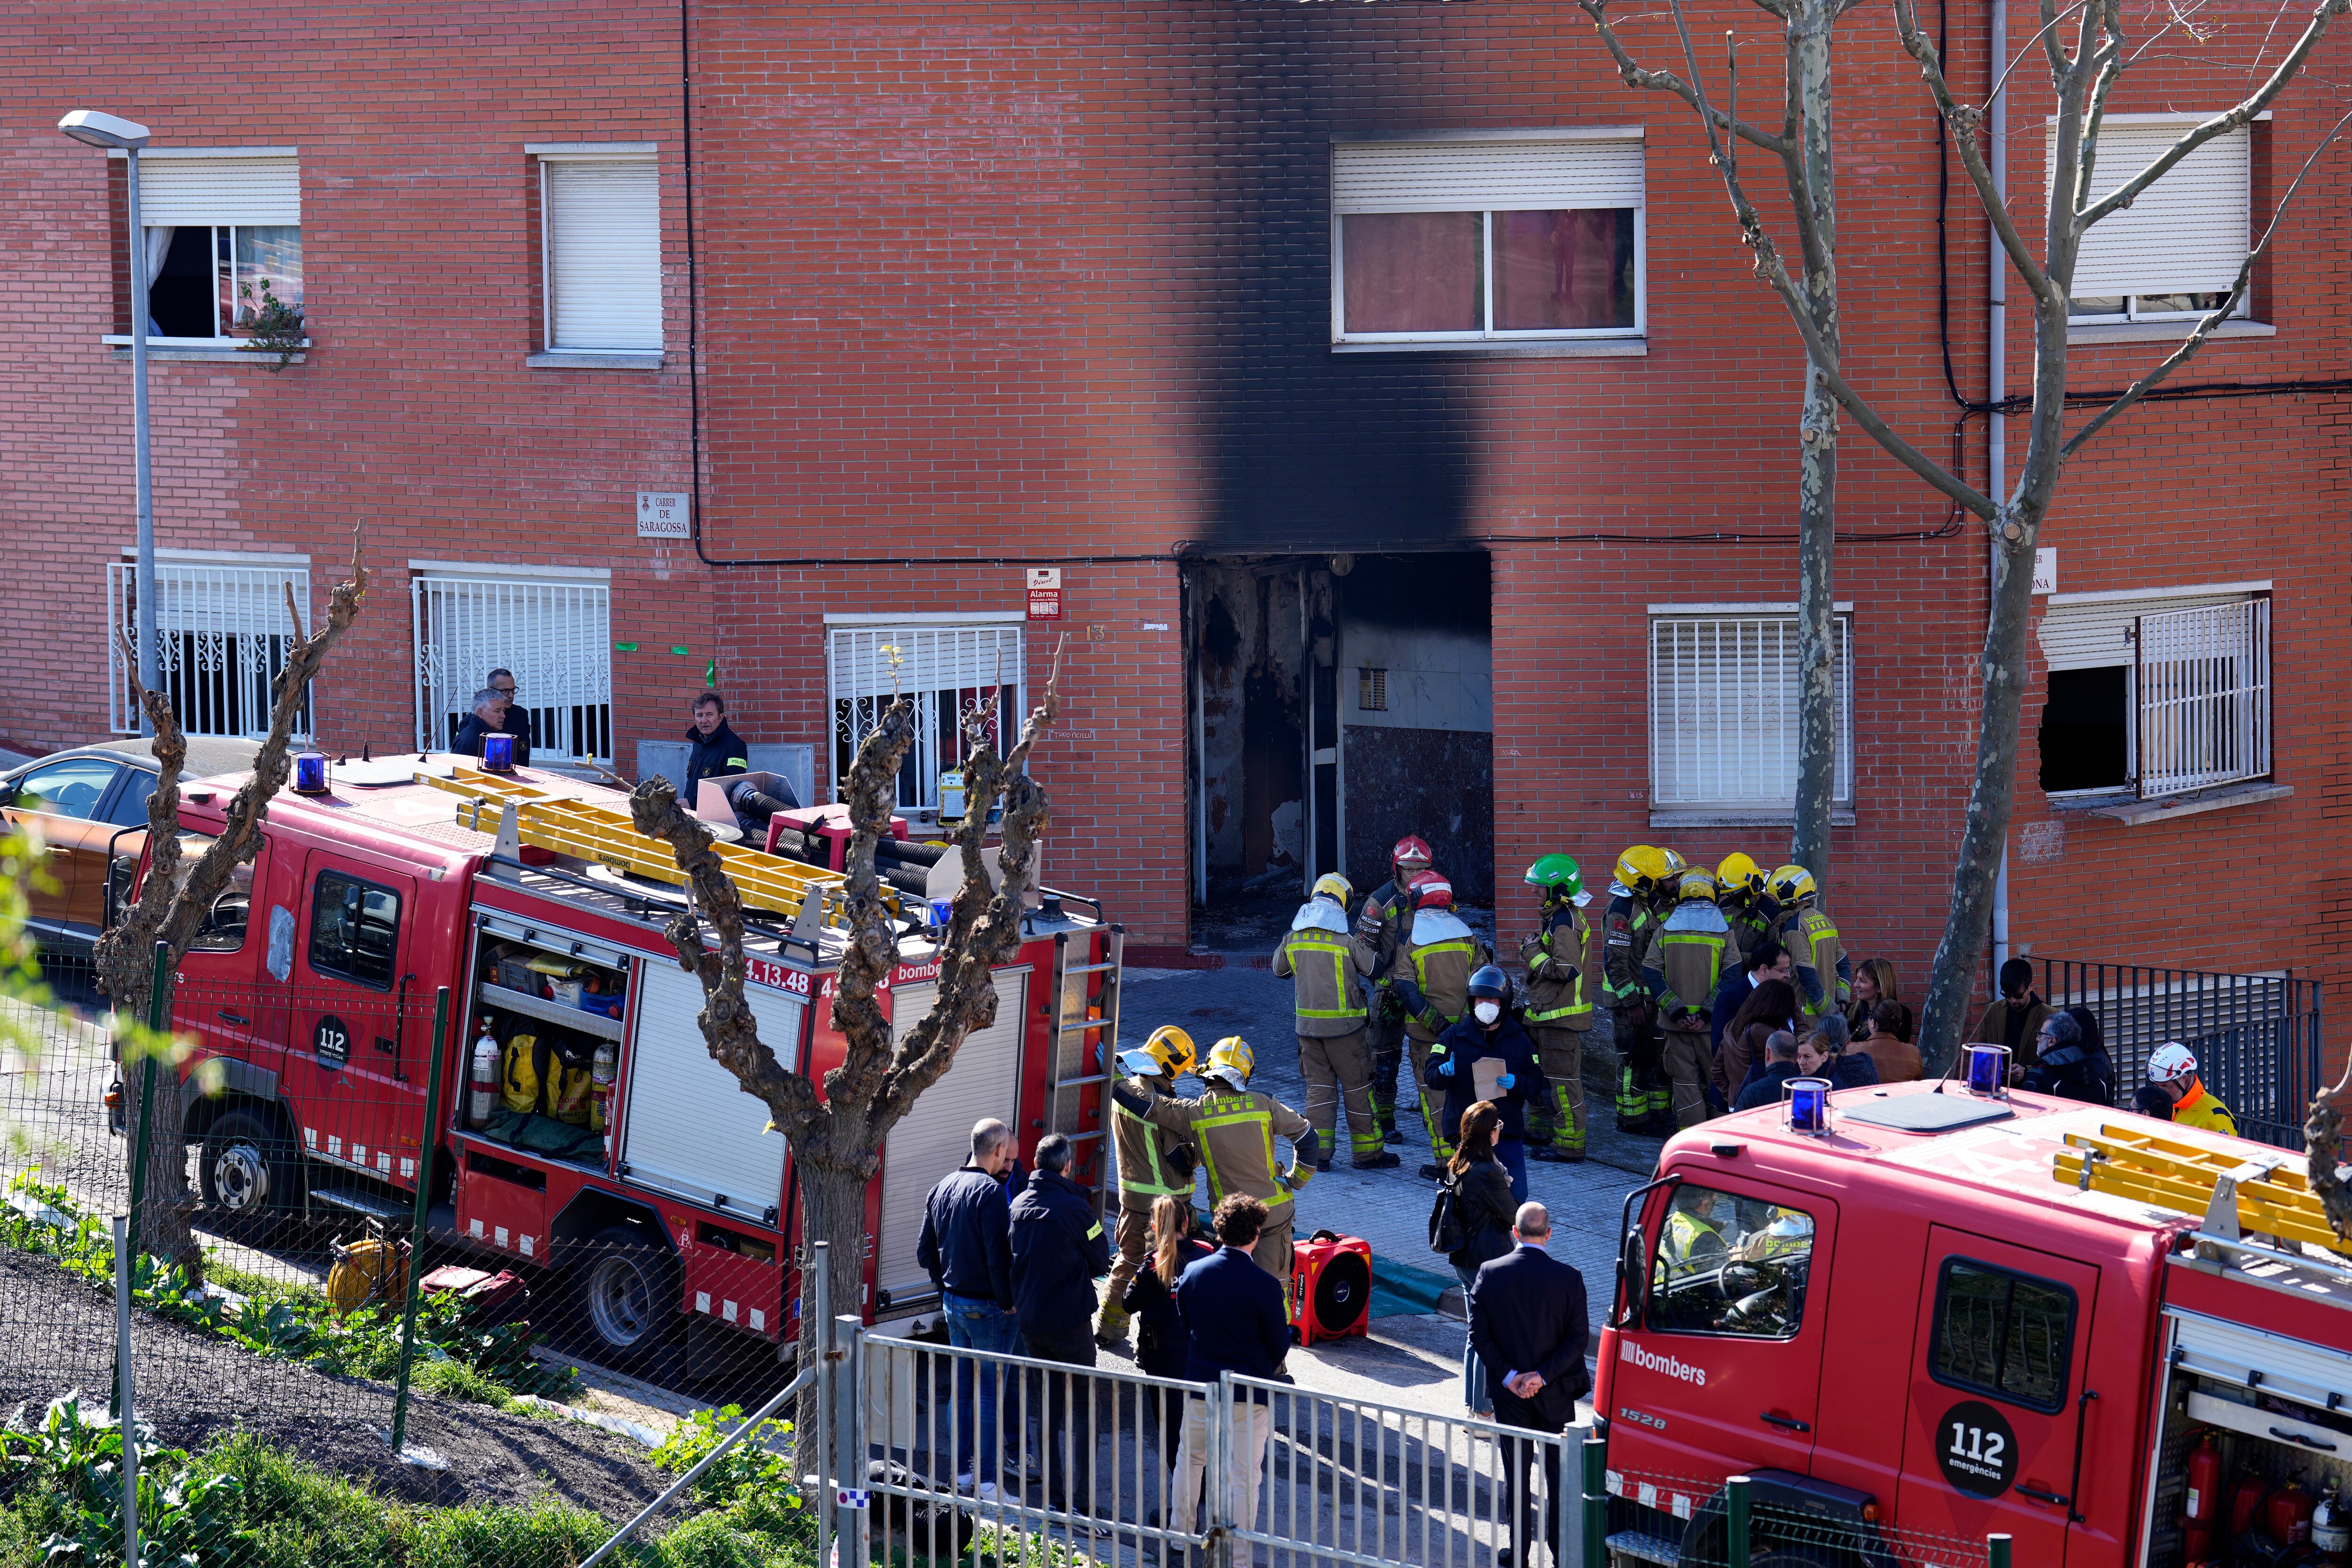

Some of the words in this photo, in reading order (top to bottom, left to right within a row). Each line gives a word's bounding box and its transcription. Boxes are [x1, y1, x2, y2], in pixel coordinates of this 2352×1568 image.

[655, 498, 676, 507] CARRER
[659, 509, 670, 518] DE
[639, 521, 687, 533] SARAGOSSA
[1033, 577, 1055, 586] Direct
[1086, 624, 1105, 641] 13
[598, 854, 630, 870] bombers
[898, 963, 941, 980] bombe
[320, 1028, 344, 1052] 112
[1202, 1095, 1253, 1106] bombers
[1635, 1344, 1706, 1386] bombers
[1620, 1407, 1667, 1430] 1528
[1950, 1422, 2004, 1467] 112
[1949, 1458, 2001, 1480] emergències
